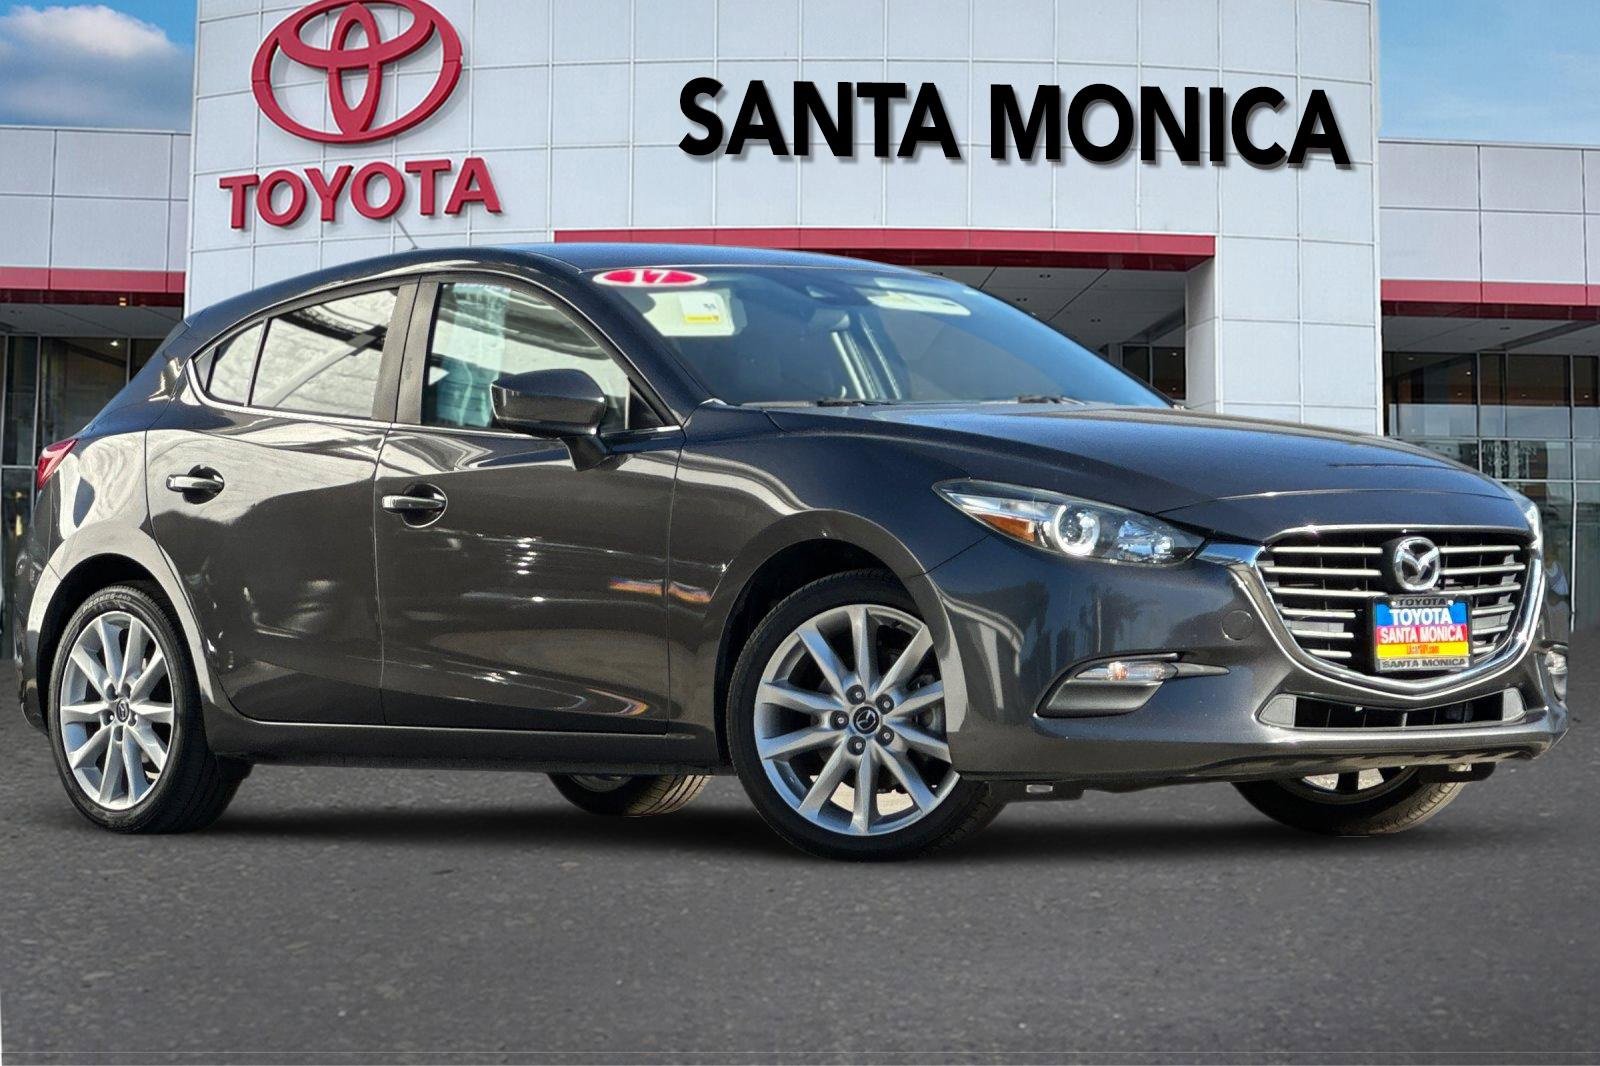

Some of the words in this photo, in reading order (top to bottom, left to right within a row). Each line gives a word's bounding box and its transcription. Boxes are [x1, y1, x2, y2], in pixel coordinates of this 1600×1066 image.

[678, 76, 961, 158] SANTA
[990, 83, 1351, 169] MONICA
[219, 157, 502, 229] TOYOTA
[1399, 598, 1447, 606] TOYOTA
[1389, 607, 1453, 626] TOYOTA
[1381, 626, 1418, 644] SANTA
[1420, 624, 1464, 643] MONICA
[1382, 659, 1419, 668] SANTA
[1422, 658, 1466, 667] MONICA
